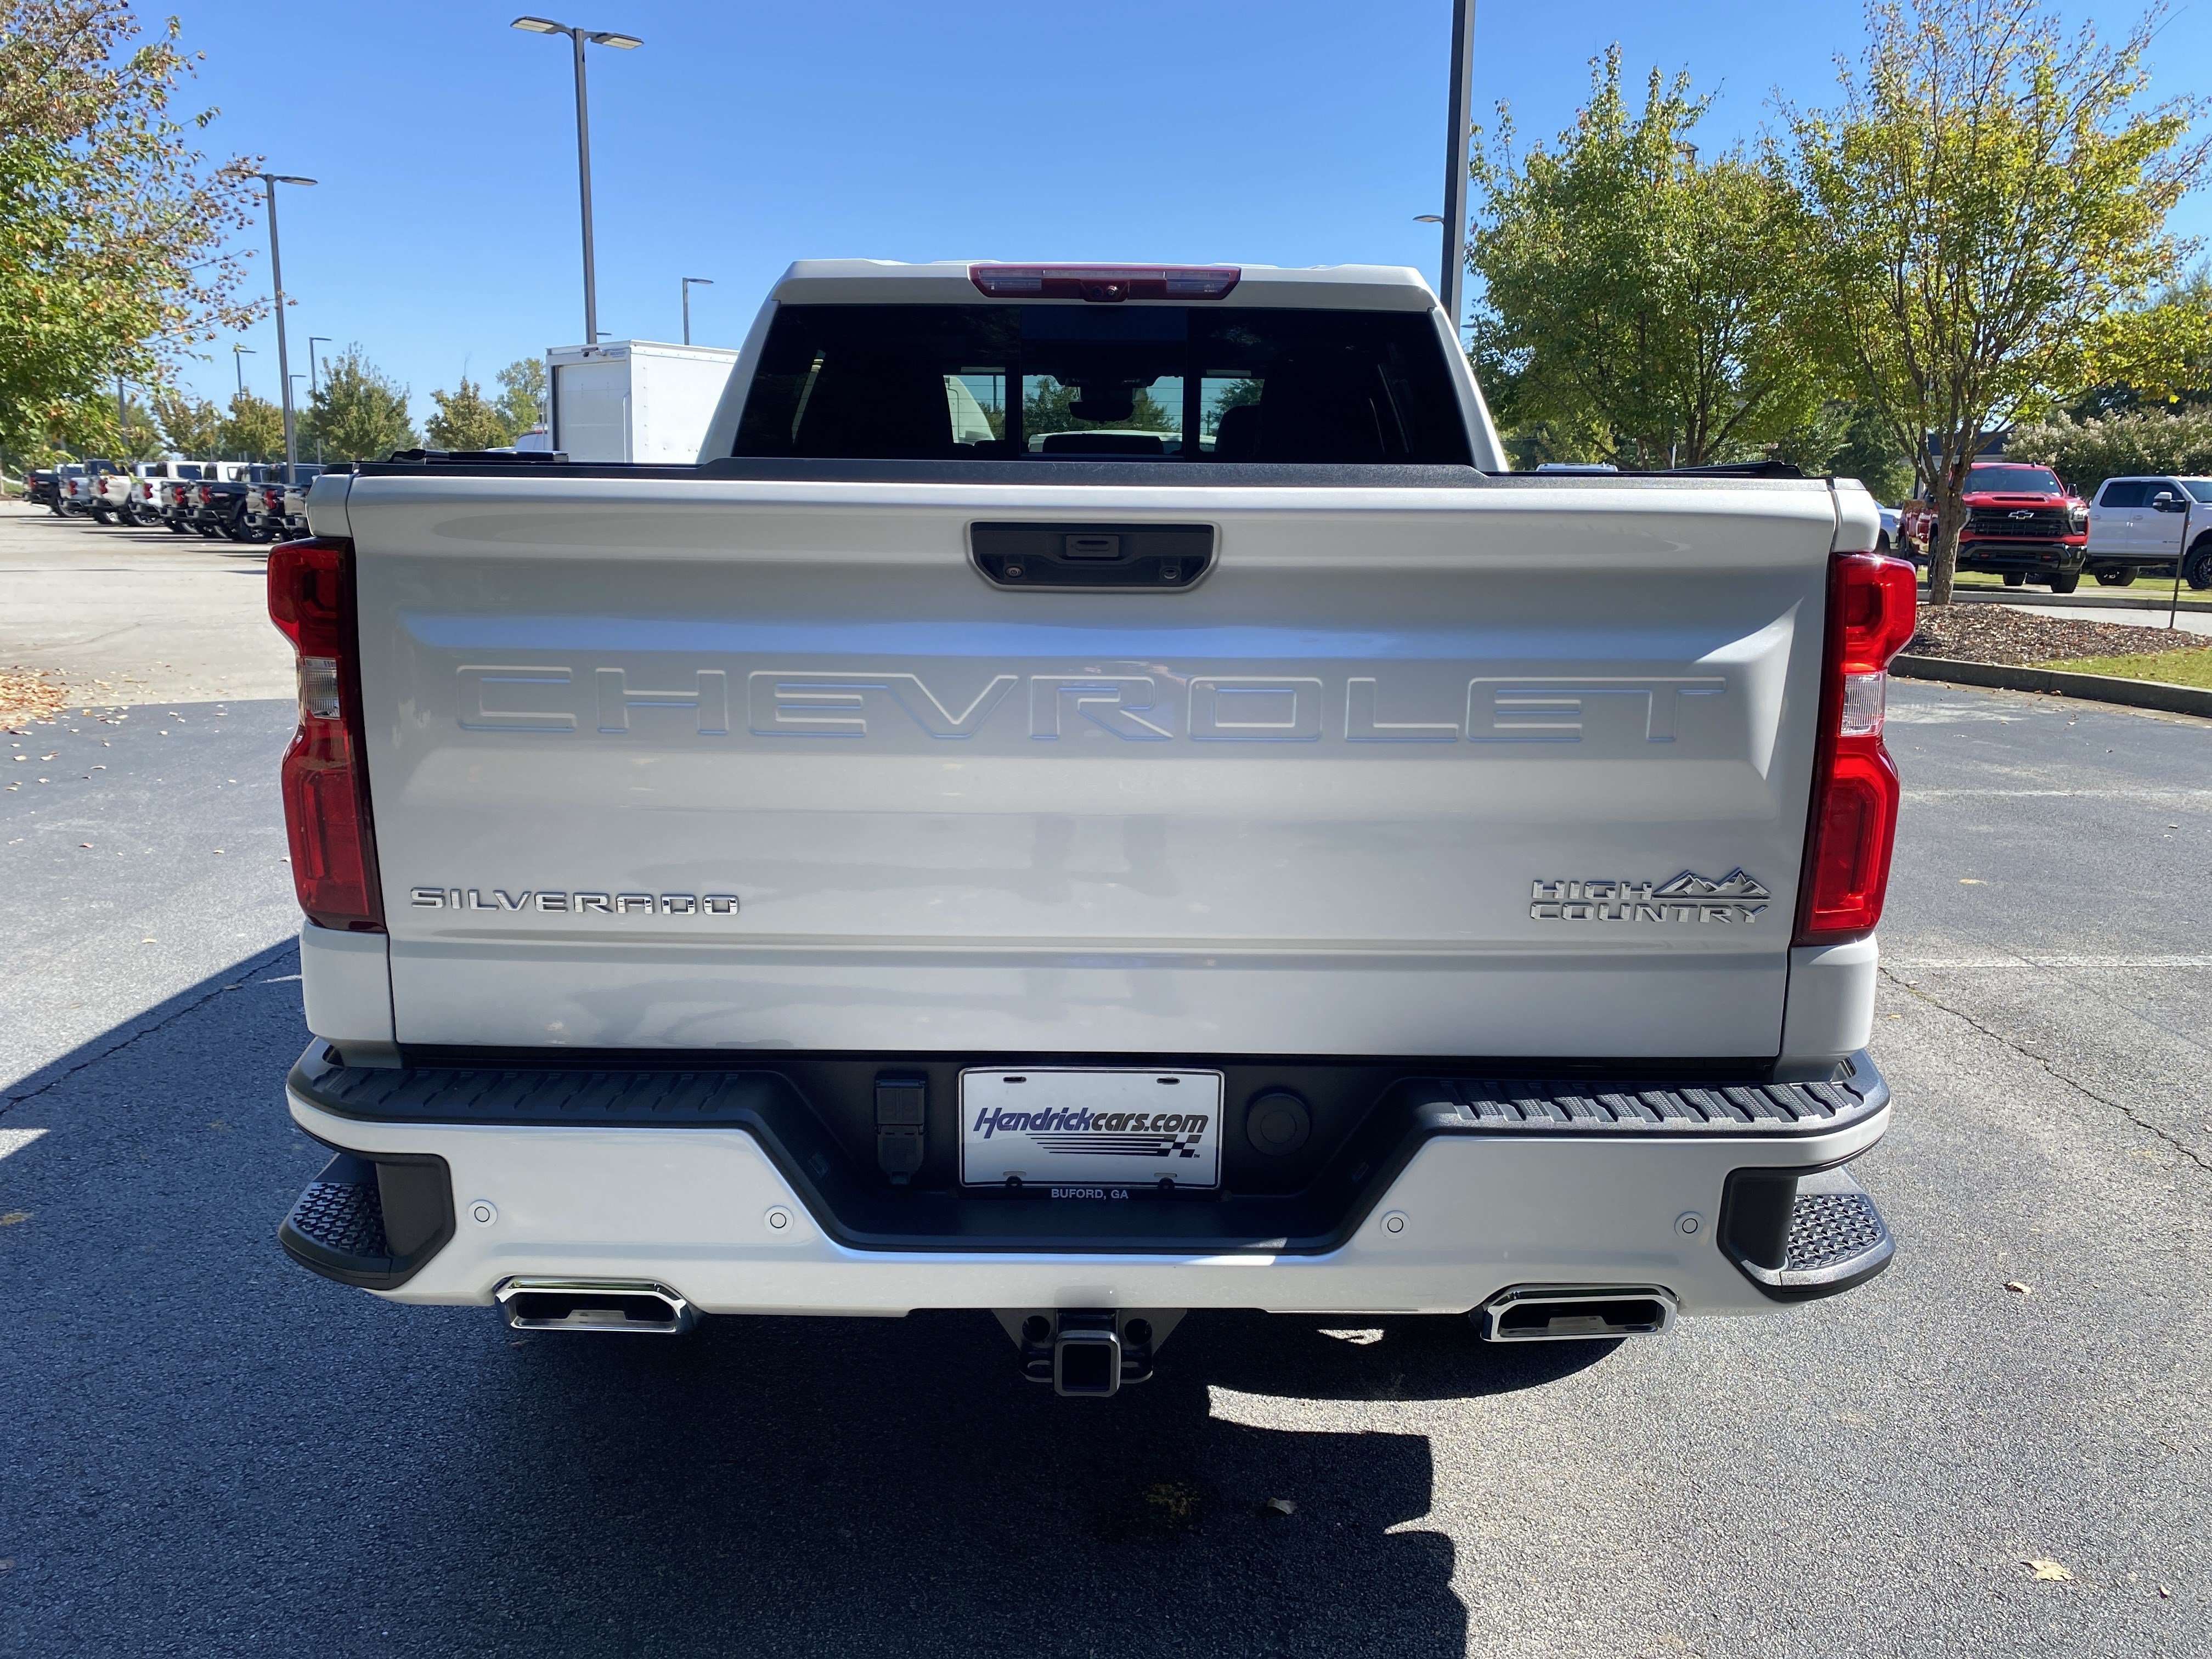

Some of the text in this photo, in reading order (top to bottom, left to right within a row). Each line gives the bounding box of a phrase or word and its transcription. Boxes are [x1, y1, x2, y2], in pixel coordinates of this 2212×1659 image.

[456, 665, 1726, 743] CHEVROLET
[410, 887, 738, 915] SILVERADO
[1533, 880, 1652, 899] HIGH
[1531, 902, 1768, 923] COUNTRY
[973, 1107, 1209, 1139] Hendrickcars.com
[1051, 1189, 1128, 1200] BUFORD, GA
